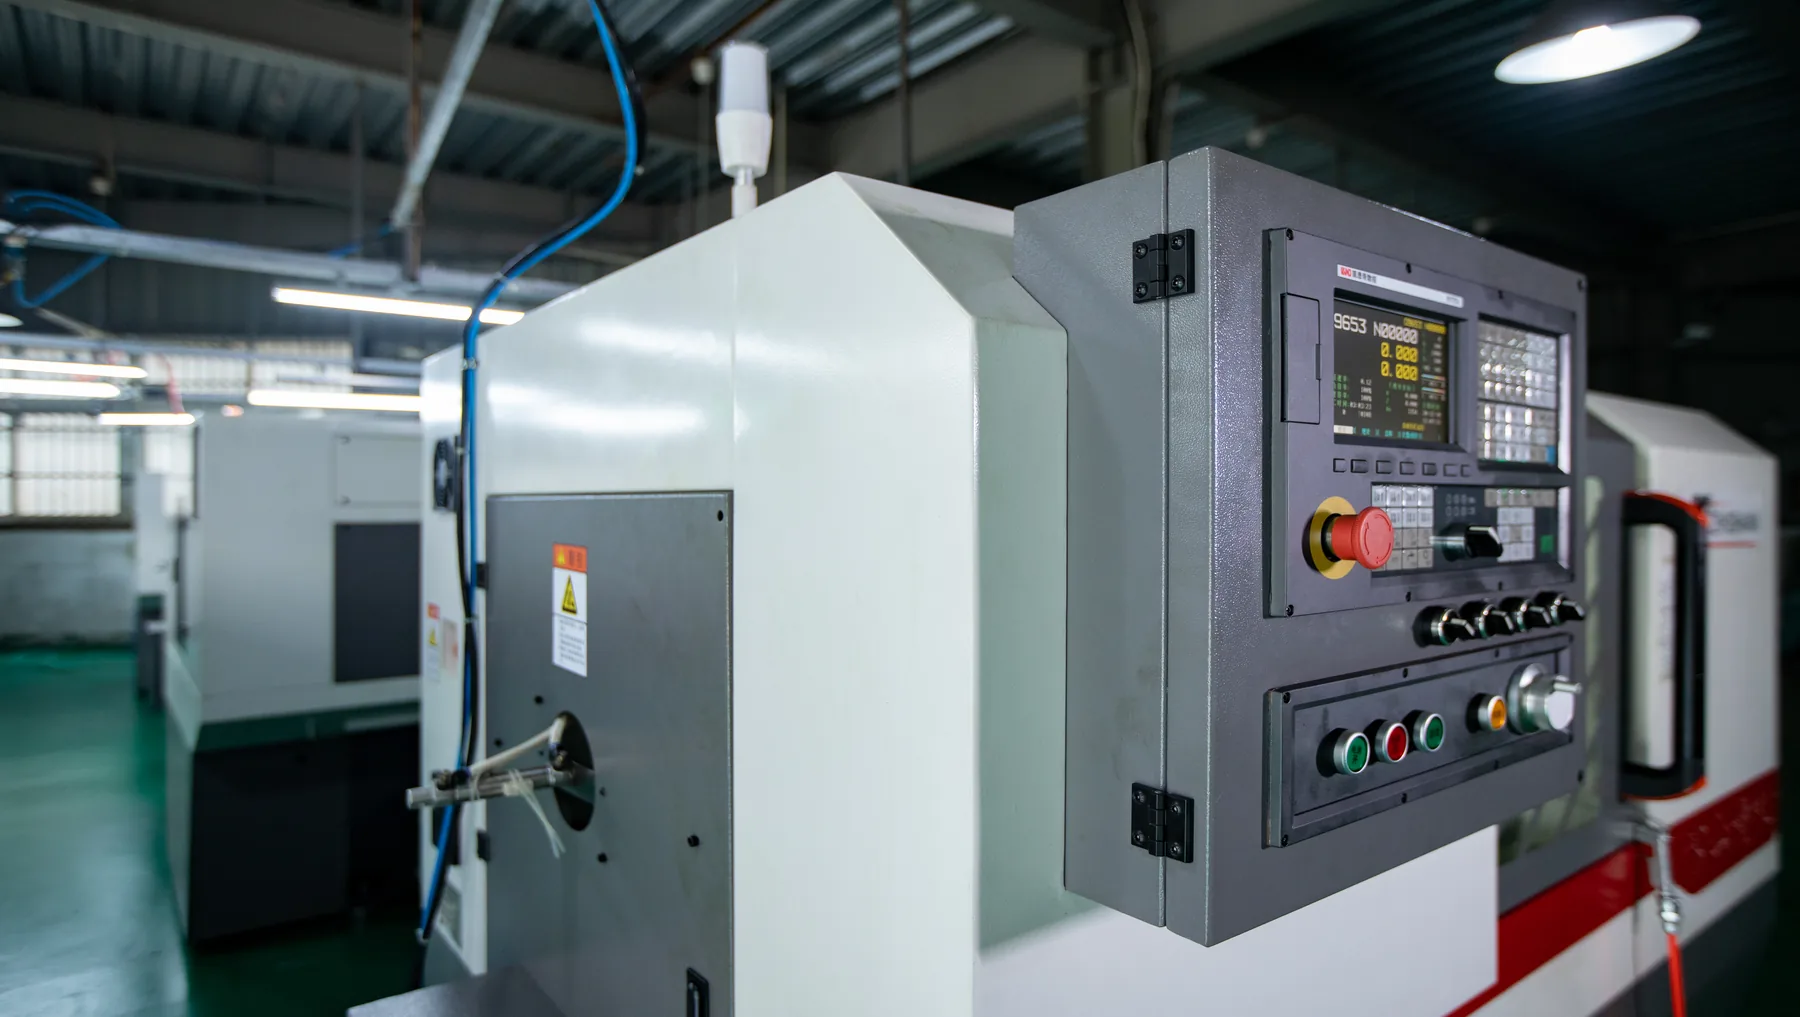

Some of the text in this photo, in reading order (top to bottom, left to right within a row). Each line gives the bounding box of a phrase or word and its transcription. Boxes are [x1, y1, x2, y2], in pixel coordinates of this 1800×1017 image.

[1334, 313, 1367, 334] 9653
[1373, 321, 1419, 344] N00000
[1381, 342, 1418, 363] 0.000
[1381, 361, 1418, 381] 0.000
